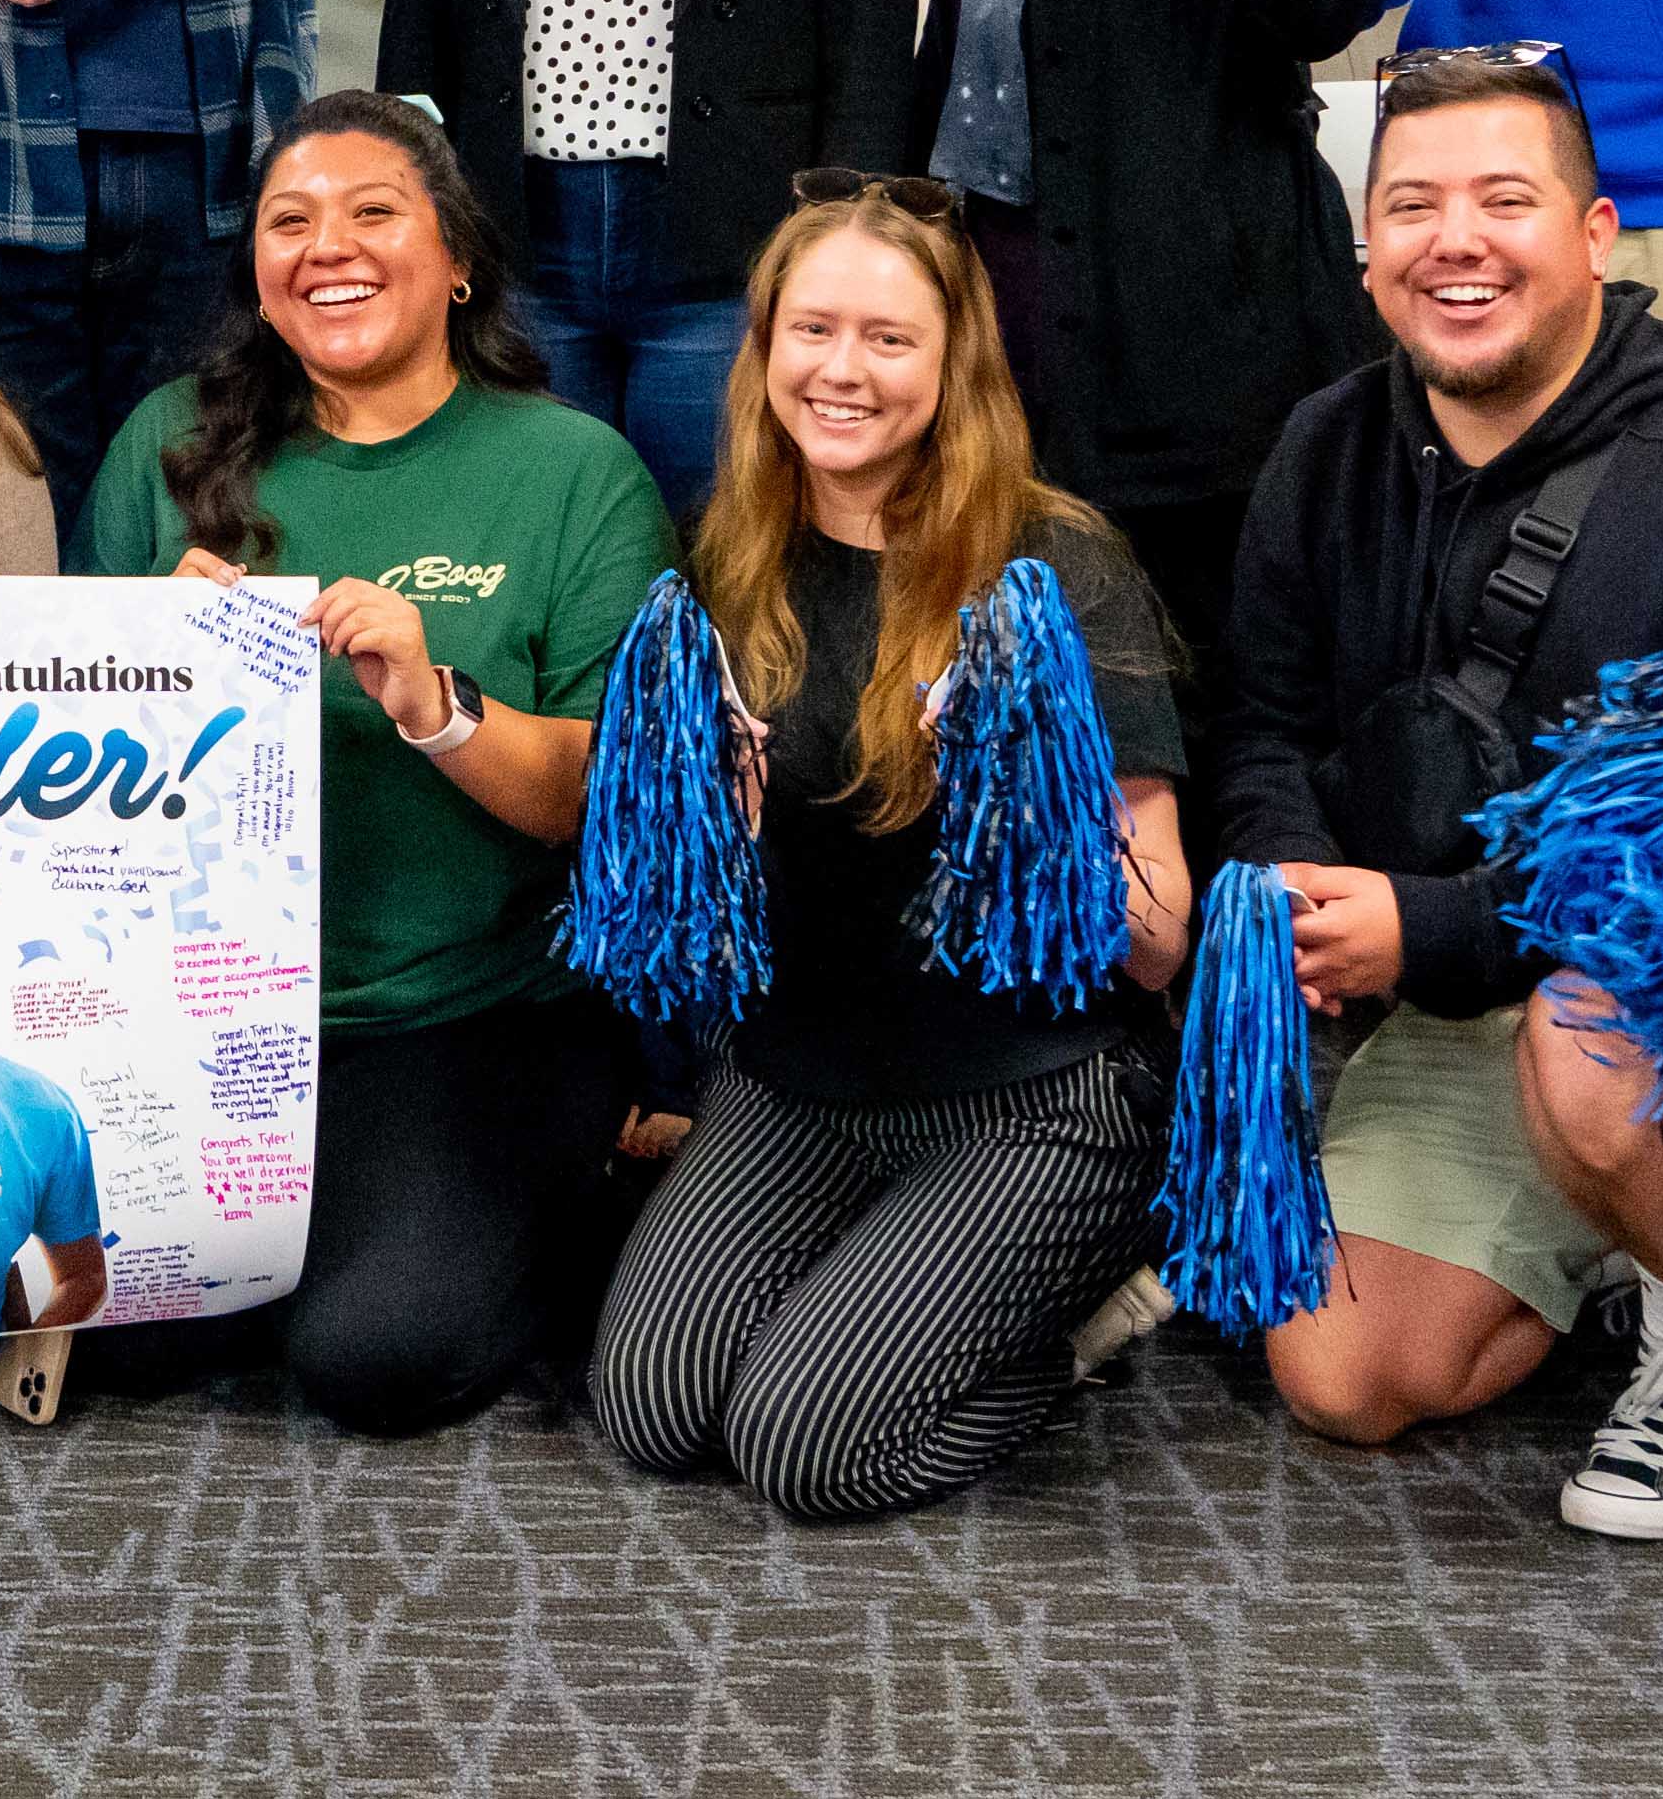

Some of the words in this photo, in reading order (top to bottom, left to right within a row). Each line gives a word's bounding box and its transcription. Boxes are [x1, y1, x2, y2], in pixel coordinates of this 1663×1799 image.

[412, 555, 507, 598] Boog
[404, 593, 437, 602] SINCE
[184, 613, 215, 635] Thank
[186, 956, 221, 969] excited
[241, 953, 262, 967] you
[181, 976, 195, 985] all
[197, 974, 221, 987] your
[200, 990, 220, 1001] are
[200, 1134, 253, 1156] Congrats
[257, 1130, 295, 1149] Tyler!
[199, 1153, 222, 1167] You
[225, 1156, 243, 1166] are
[234, 1166, 255, 1179] well
[259, 1162, 312, 1179] deserved!
[258, 1182, 275, 1193] are
[243, 1195, 251, 1205] a
[255, 1192, 286, 1206] STAR!
